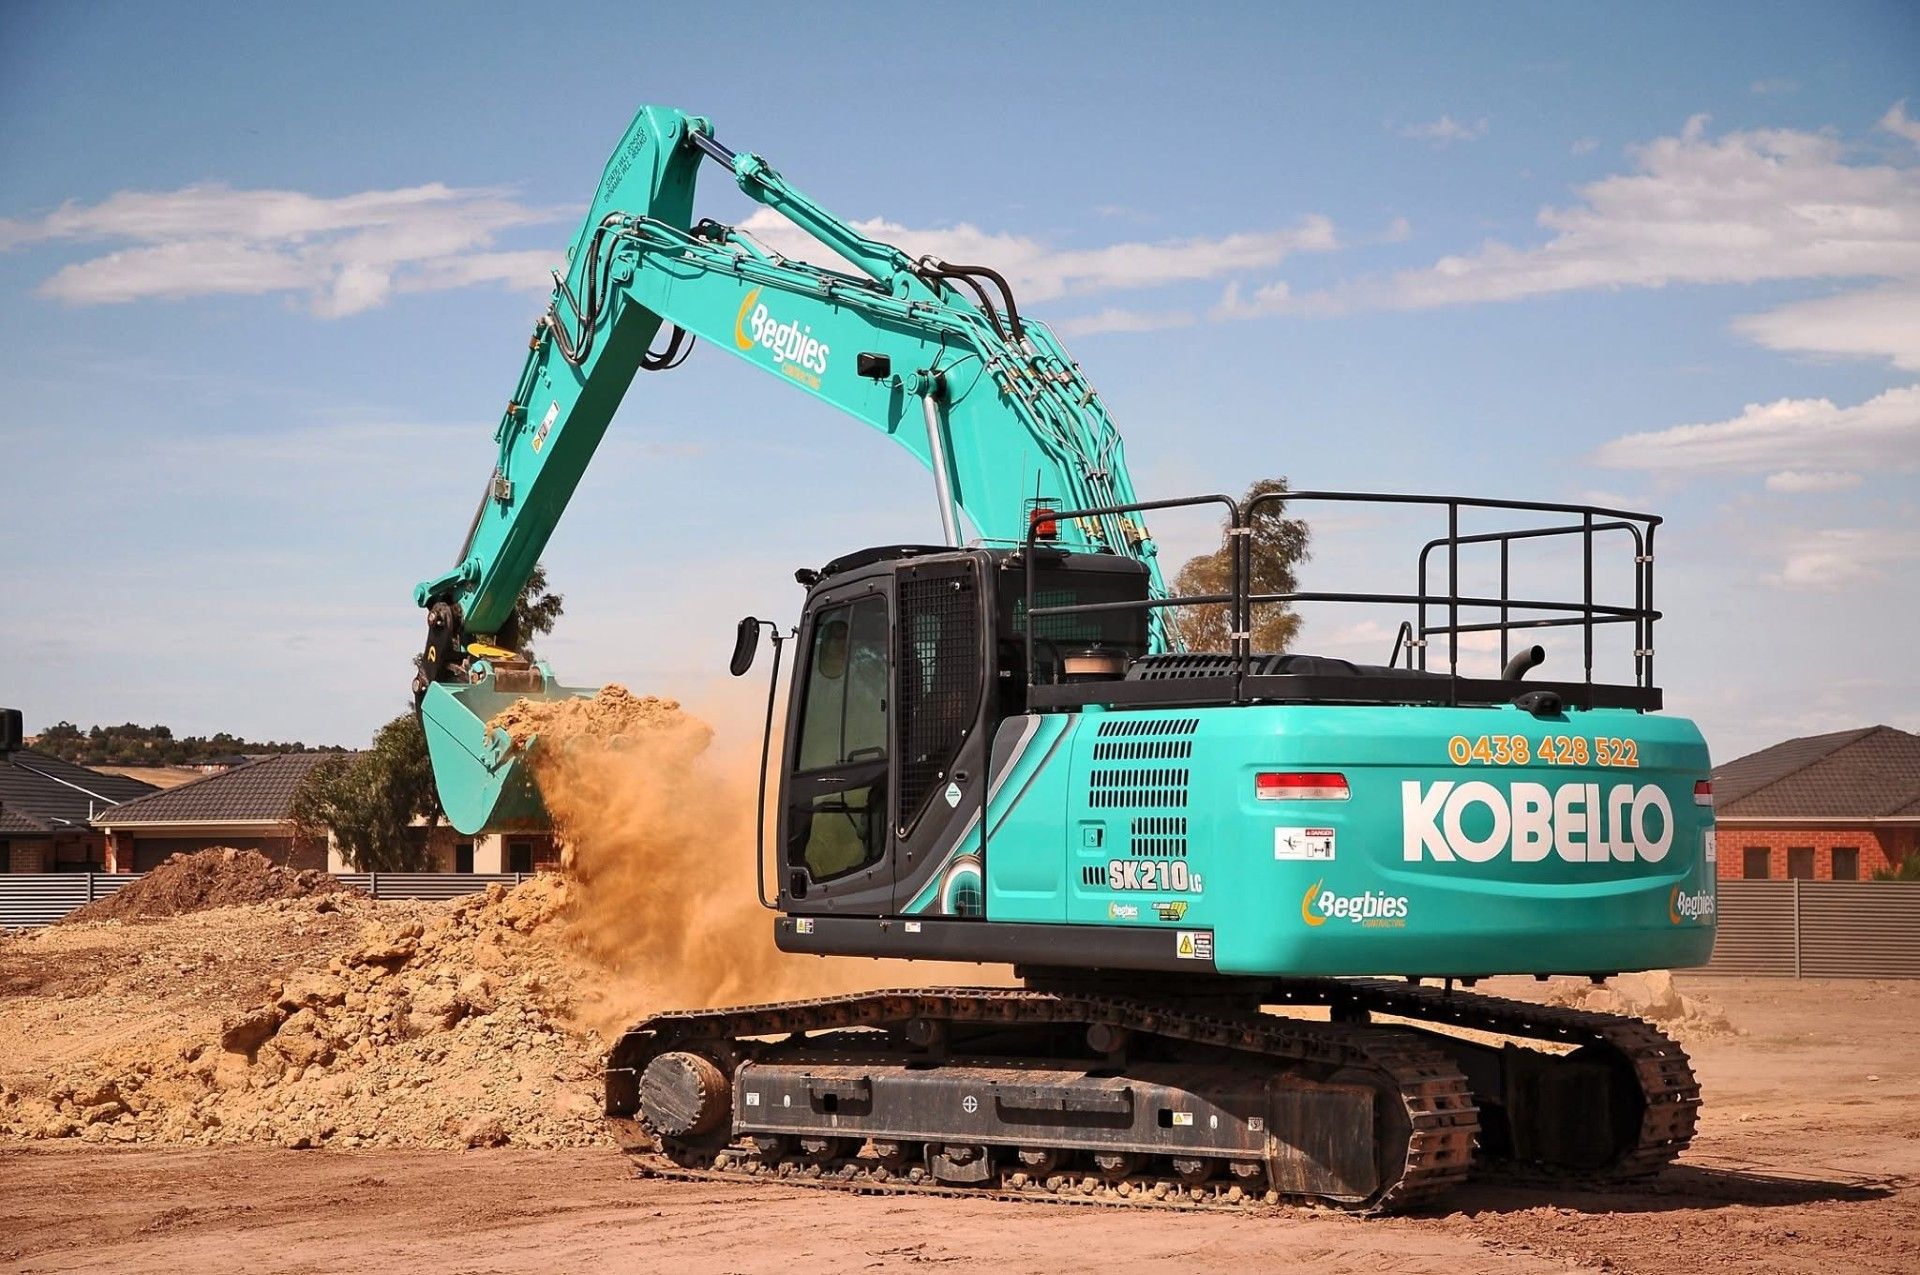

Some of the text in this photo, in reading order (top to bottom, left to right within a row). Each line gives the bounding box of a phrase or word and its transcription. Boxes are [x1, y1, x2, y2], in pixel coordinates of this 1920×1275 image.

[751, 303, 830, 375] Begbies
[1448, 735, 1639, 767] 0438 428 522
[1401, 780, 1674, 862] KOBELCO
[1317, 890, 1408, 923] Begbies
[1677, 890, 1714, 920] Begbies
